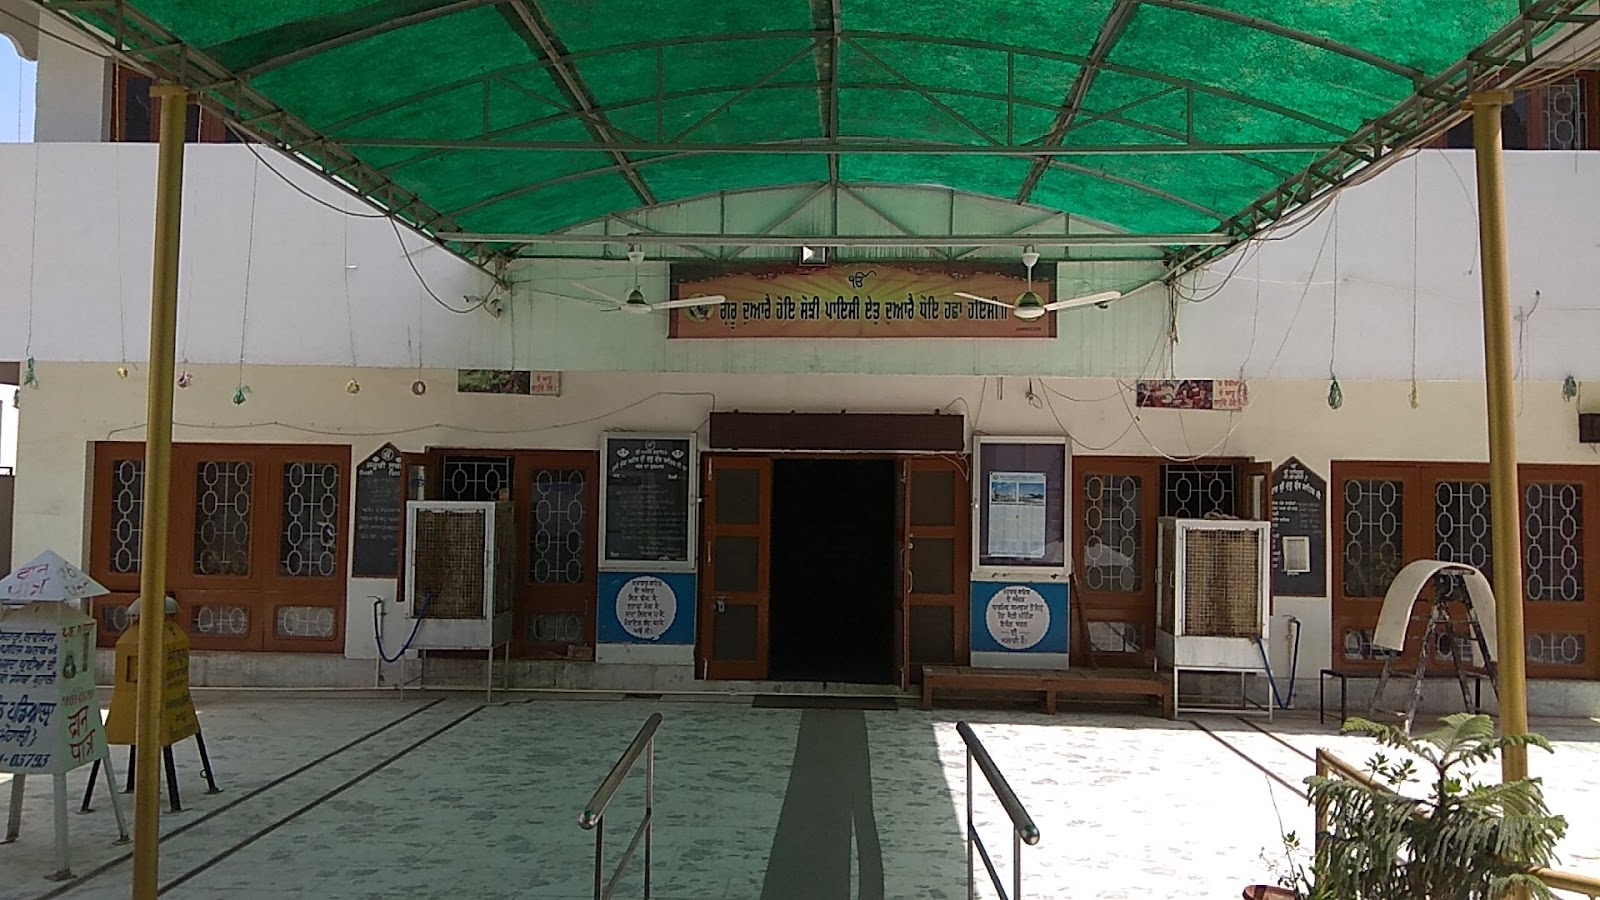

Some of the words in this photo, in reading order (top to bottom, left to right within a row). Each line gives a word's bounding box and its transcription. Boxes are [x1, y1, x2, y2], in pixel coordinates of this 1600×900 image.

[742, 293, 771, 325] ਦੁਆਰੈ
[776, 296, 795, 320] ਹੋਇ
[800, 295, 820, 320] ਸੋਝੀ
[825, 295, 860, 320] ਪਾਇਸੀ
[885, 293, 914, 325] ਦੁਆਰੈ
